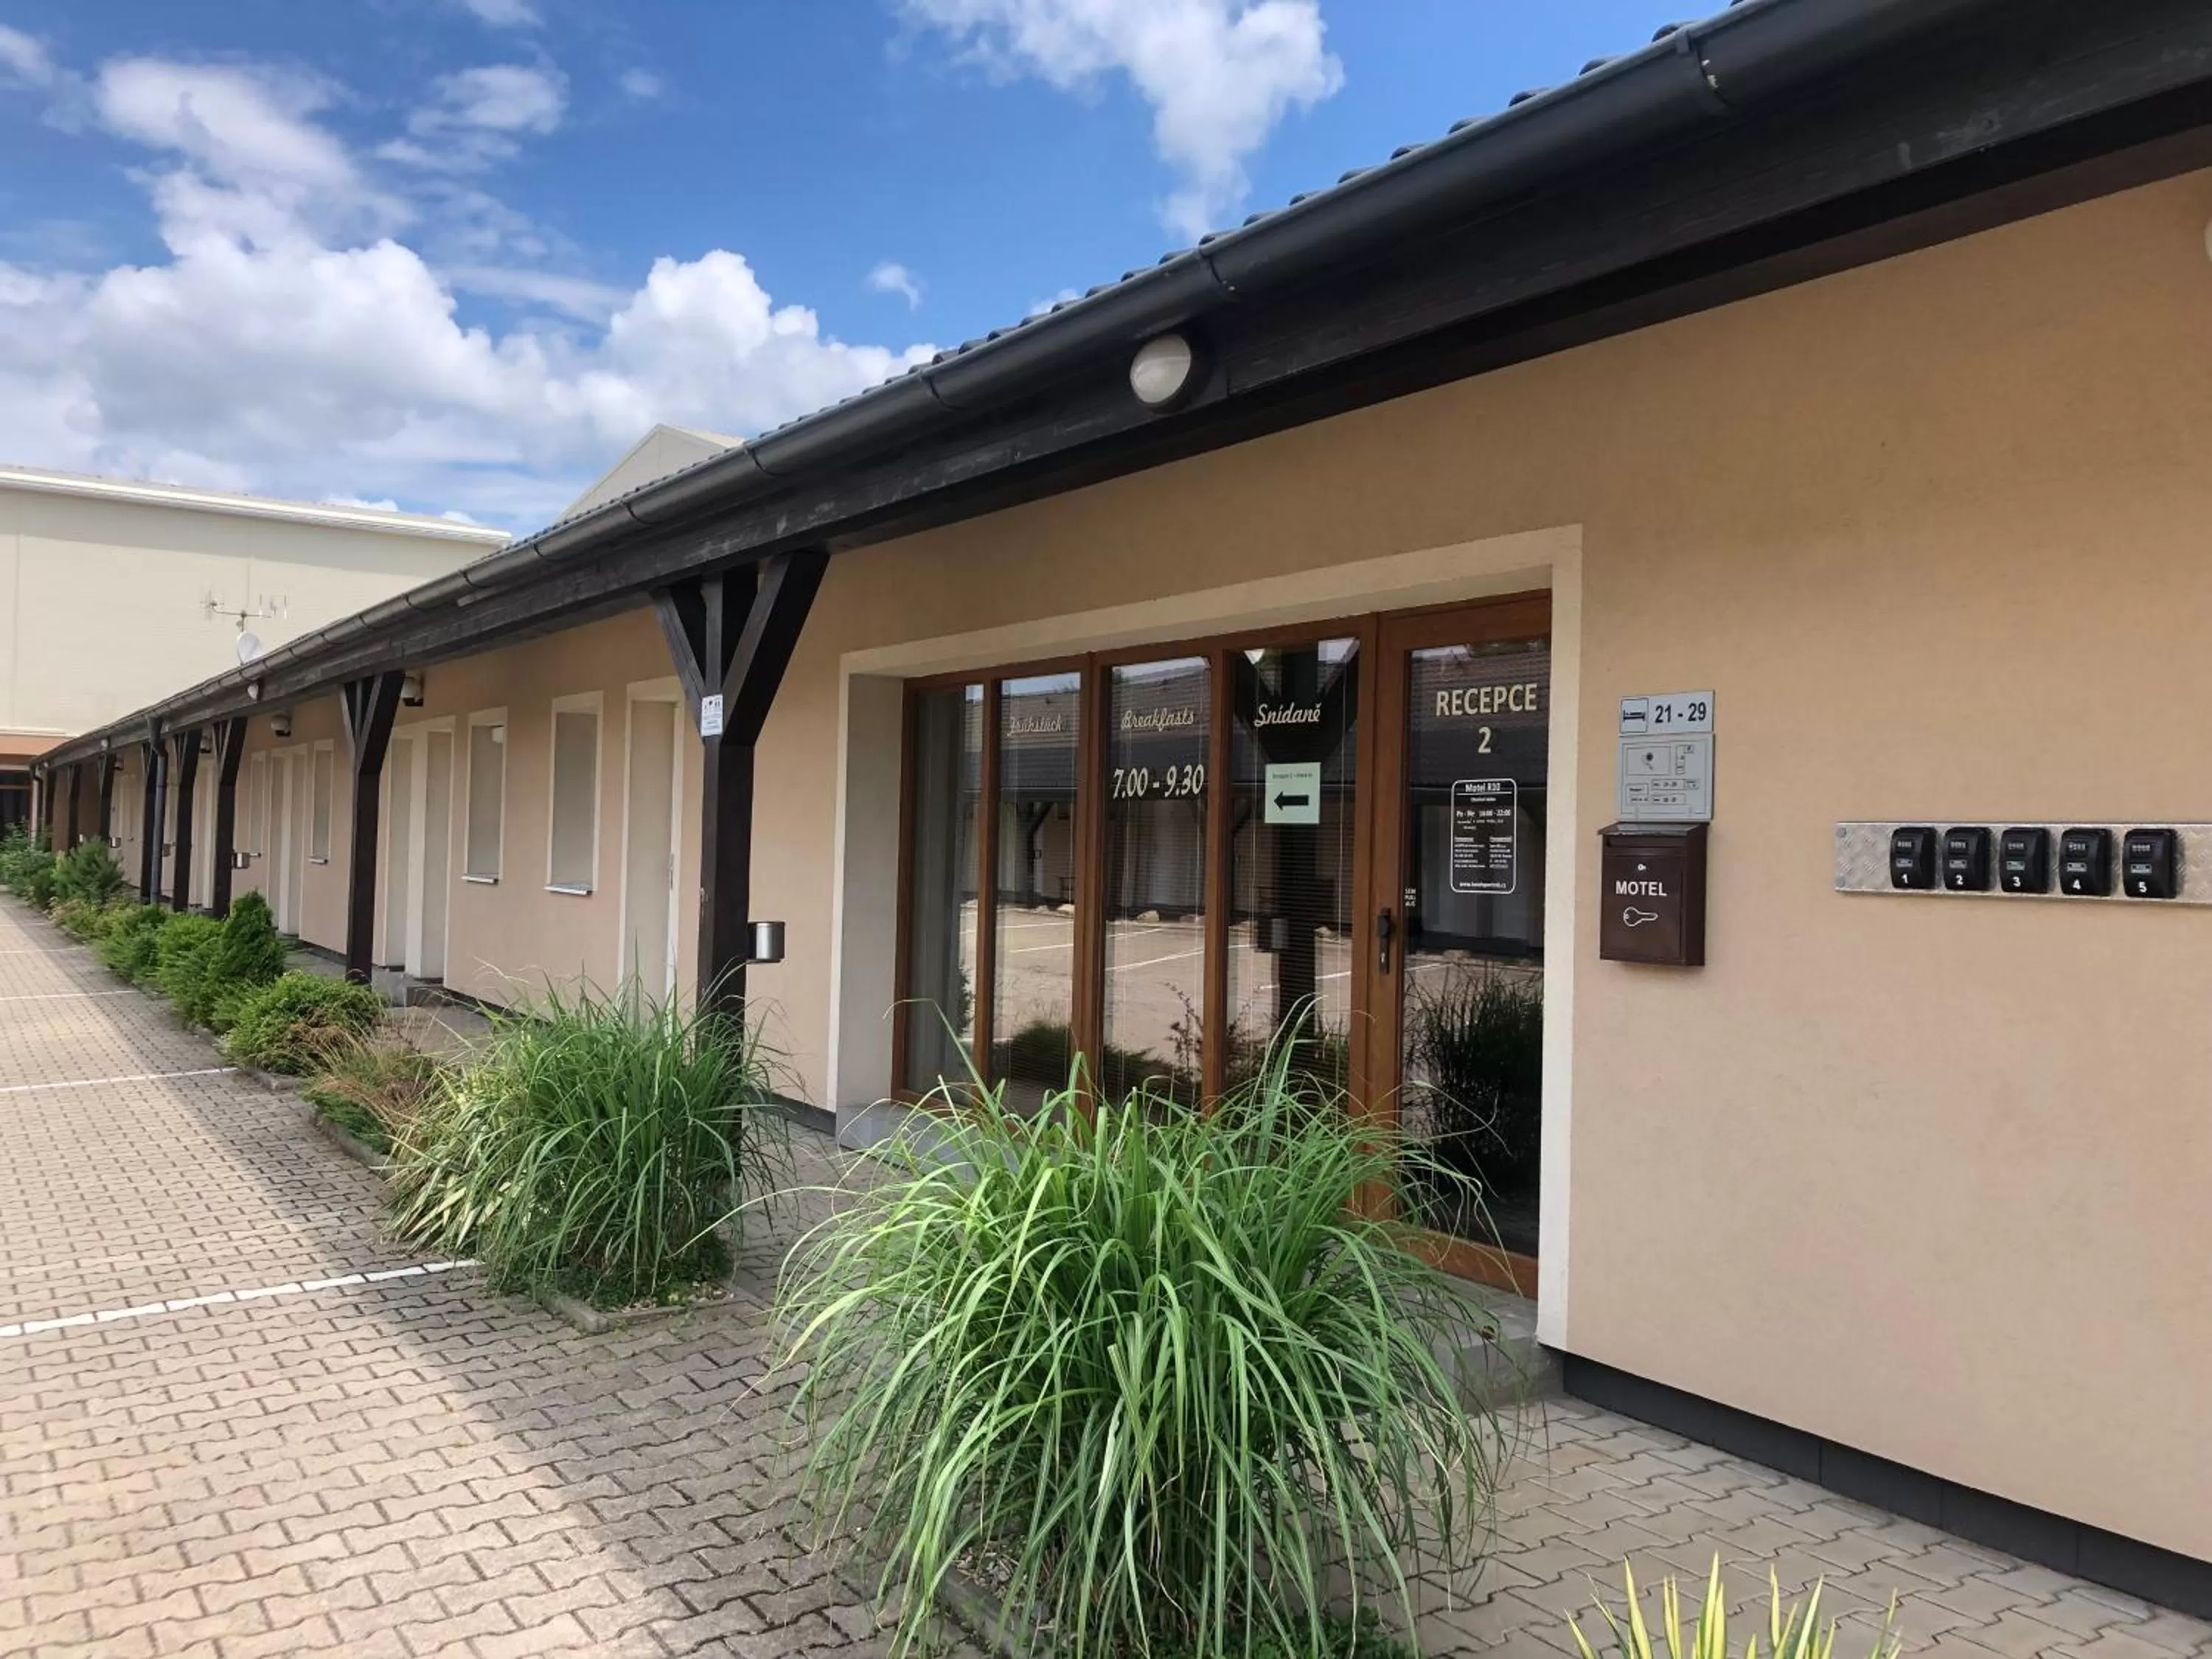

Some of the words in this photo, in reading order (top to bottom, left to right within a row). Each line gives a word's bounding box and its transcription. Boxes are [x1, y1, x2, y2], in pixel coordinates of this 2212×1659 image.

[1436, 684, 1537, 716] RECEPCE
[1121, 707, 1194, 731] Breakfasts
[1655, 704, 1672, 723] 21
[1688, 701, 1707, 722] 29
[1478, 726, 1492, 754] 2
[1113, 768, 1148, 799] 7.00
[1164, 764, 1204, 797] 9.30
[1902, 873, 1908, 884] 1
[1955, 874, 1964, 886] 2
[2012, 876, 2021, 888] 3
[2073, 879, 2081, 890] 4
[1615, 880, 1667, 897] MOTEL
[2138, 881, 2147, 894] 5
